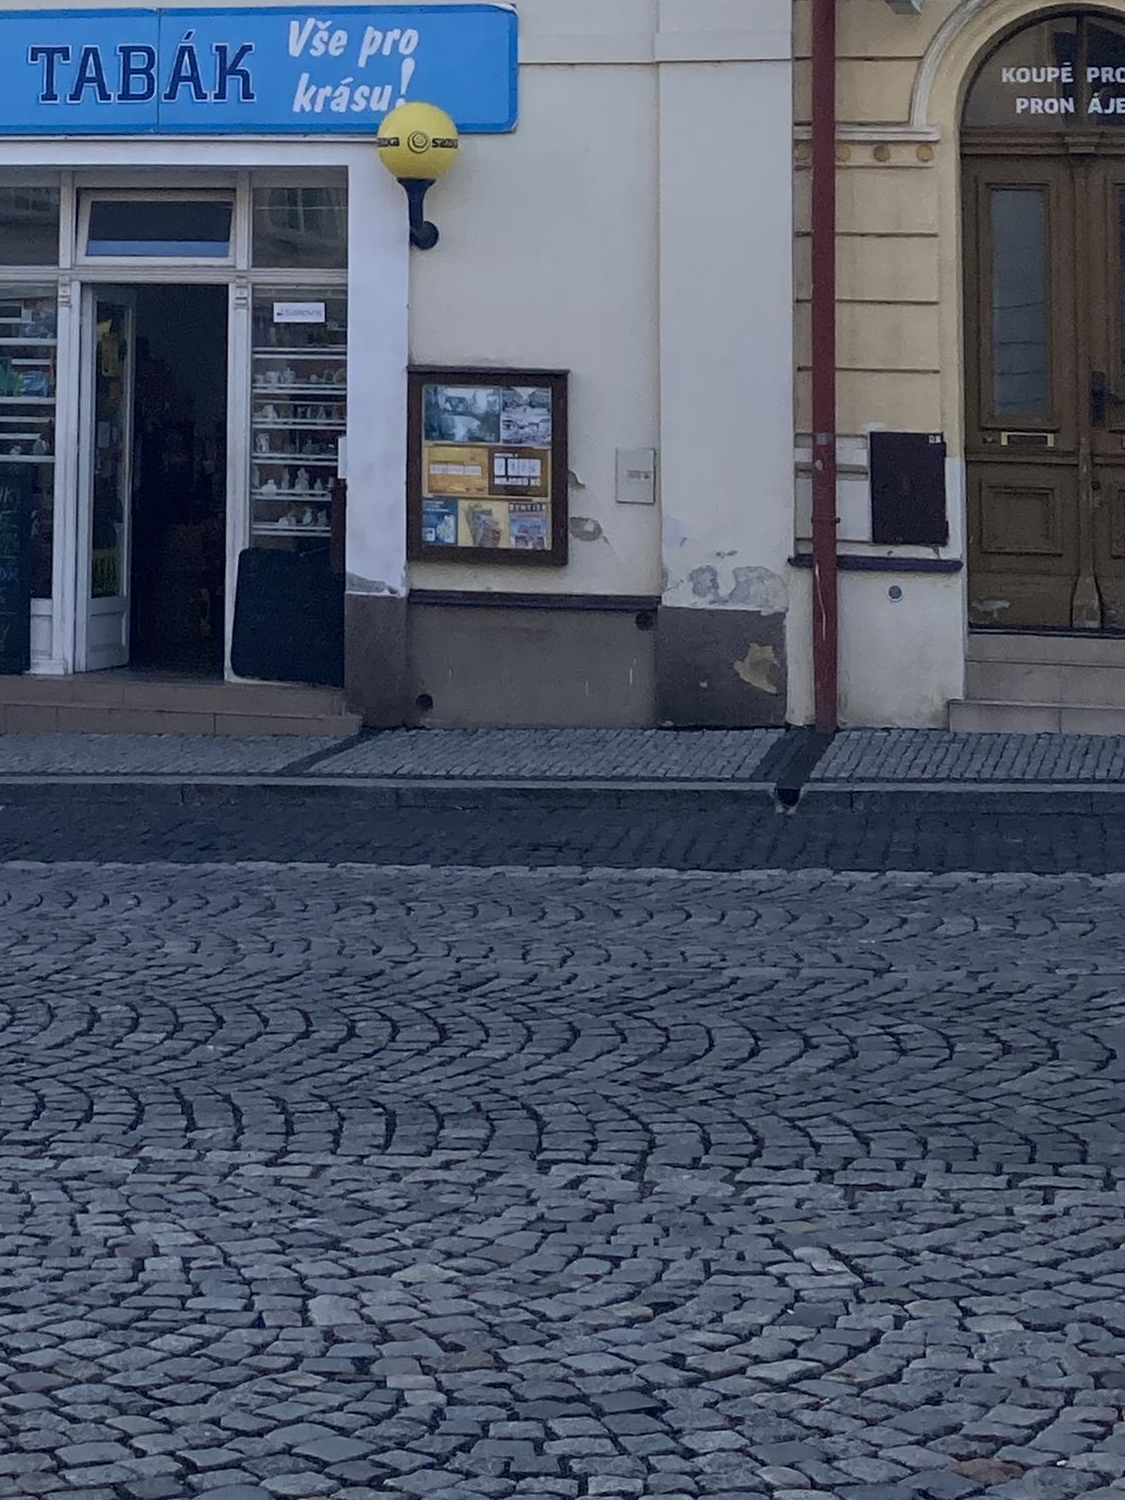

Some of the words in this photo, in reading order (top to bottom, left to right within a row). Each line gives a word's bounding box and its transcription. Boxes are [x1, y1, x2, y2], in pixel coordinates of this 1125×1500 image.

[27, 28, 257, 103] TABÁK
[289, 17, 348, 57] Vše
[358, 26, 419, 68] pro
[292, 57, 416, 113] krásu!
